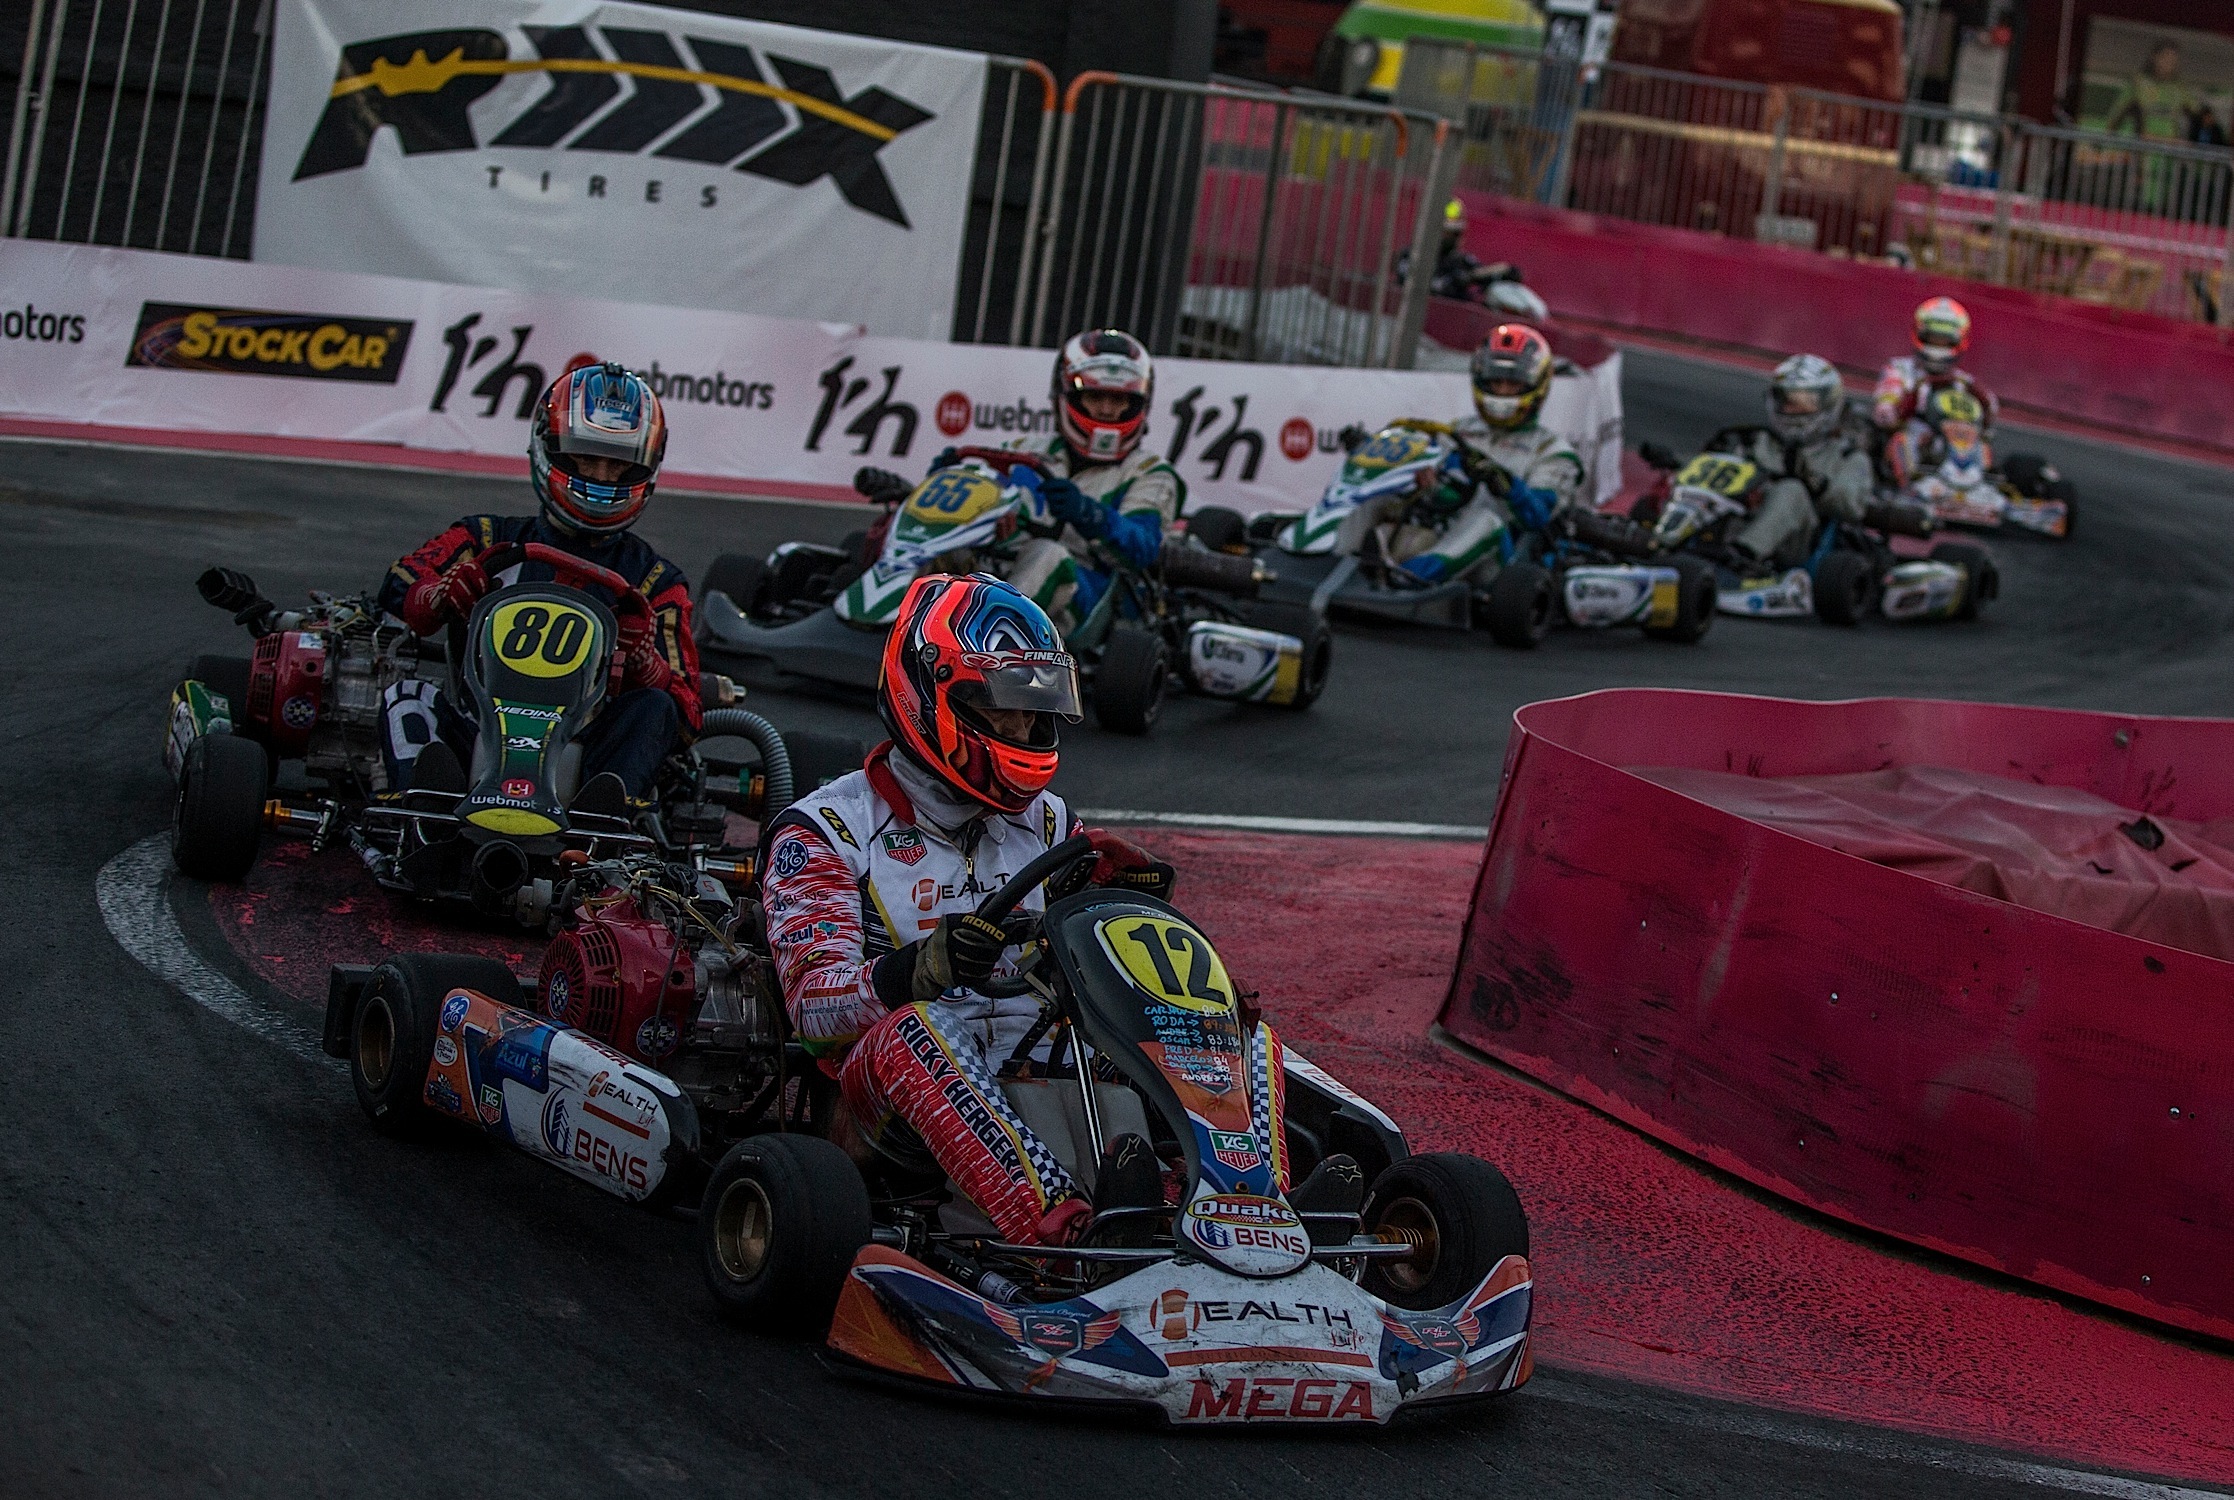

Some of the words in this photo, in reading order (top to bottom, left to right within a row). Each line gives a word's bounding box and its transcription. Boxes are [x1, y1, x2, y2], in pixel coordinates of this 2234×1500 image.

[487, 164, 719, 208] TIRES
[916, 473, 983, 514] 55
[500, 606, 588, 666] 80
[492, 705, 562, 722] MEDINA
[506, 735, 542, 749] MX
[889, 833, 915, 847] TAG
[890, 848, 925, 864] HEUER
[778, 923, 812, 944] Azul
[1127, 923, 1228, 1006] 12
[498, 1042, 529, 1070] Azul
[895, 1012, 960, 1084] RICKY
[484, 1088, 499, 1106] TAG
[480, 1103, 501, 1121] HEUER
[1217, 1134, 1250, 1150] TAG
[574, 1127, 648, 1190] BENS
[1217, 1150, 1259, 1169] HEUER
[1193, 1198, 1297, 1223] Quake
[1234, 1227, 1305, 1255] BENS
[1182, 1376, 1380, 1420] MEGA
